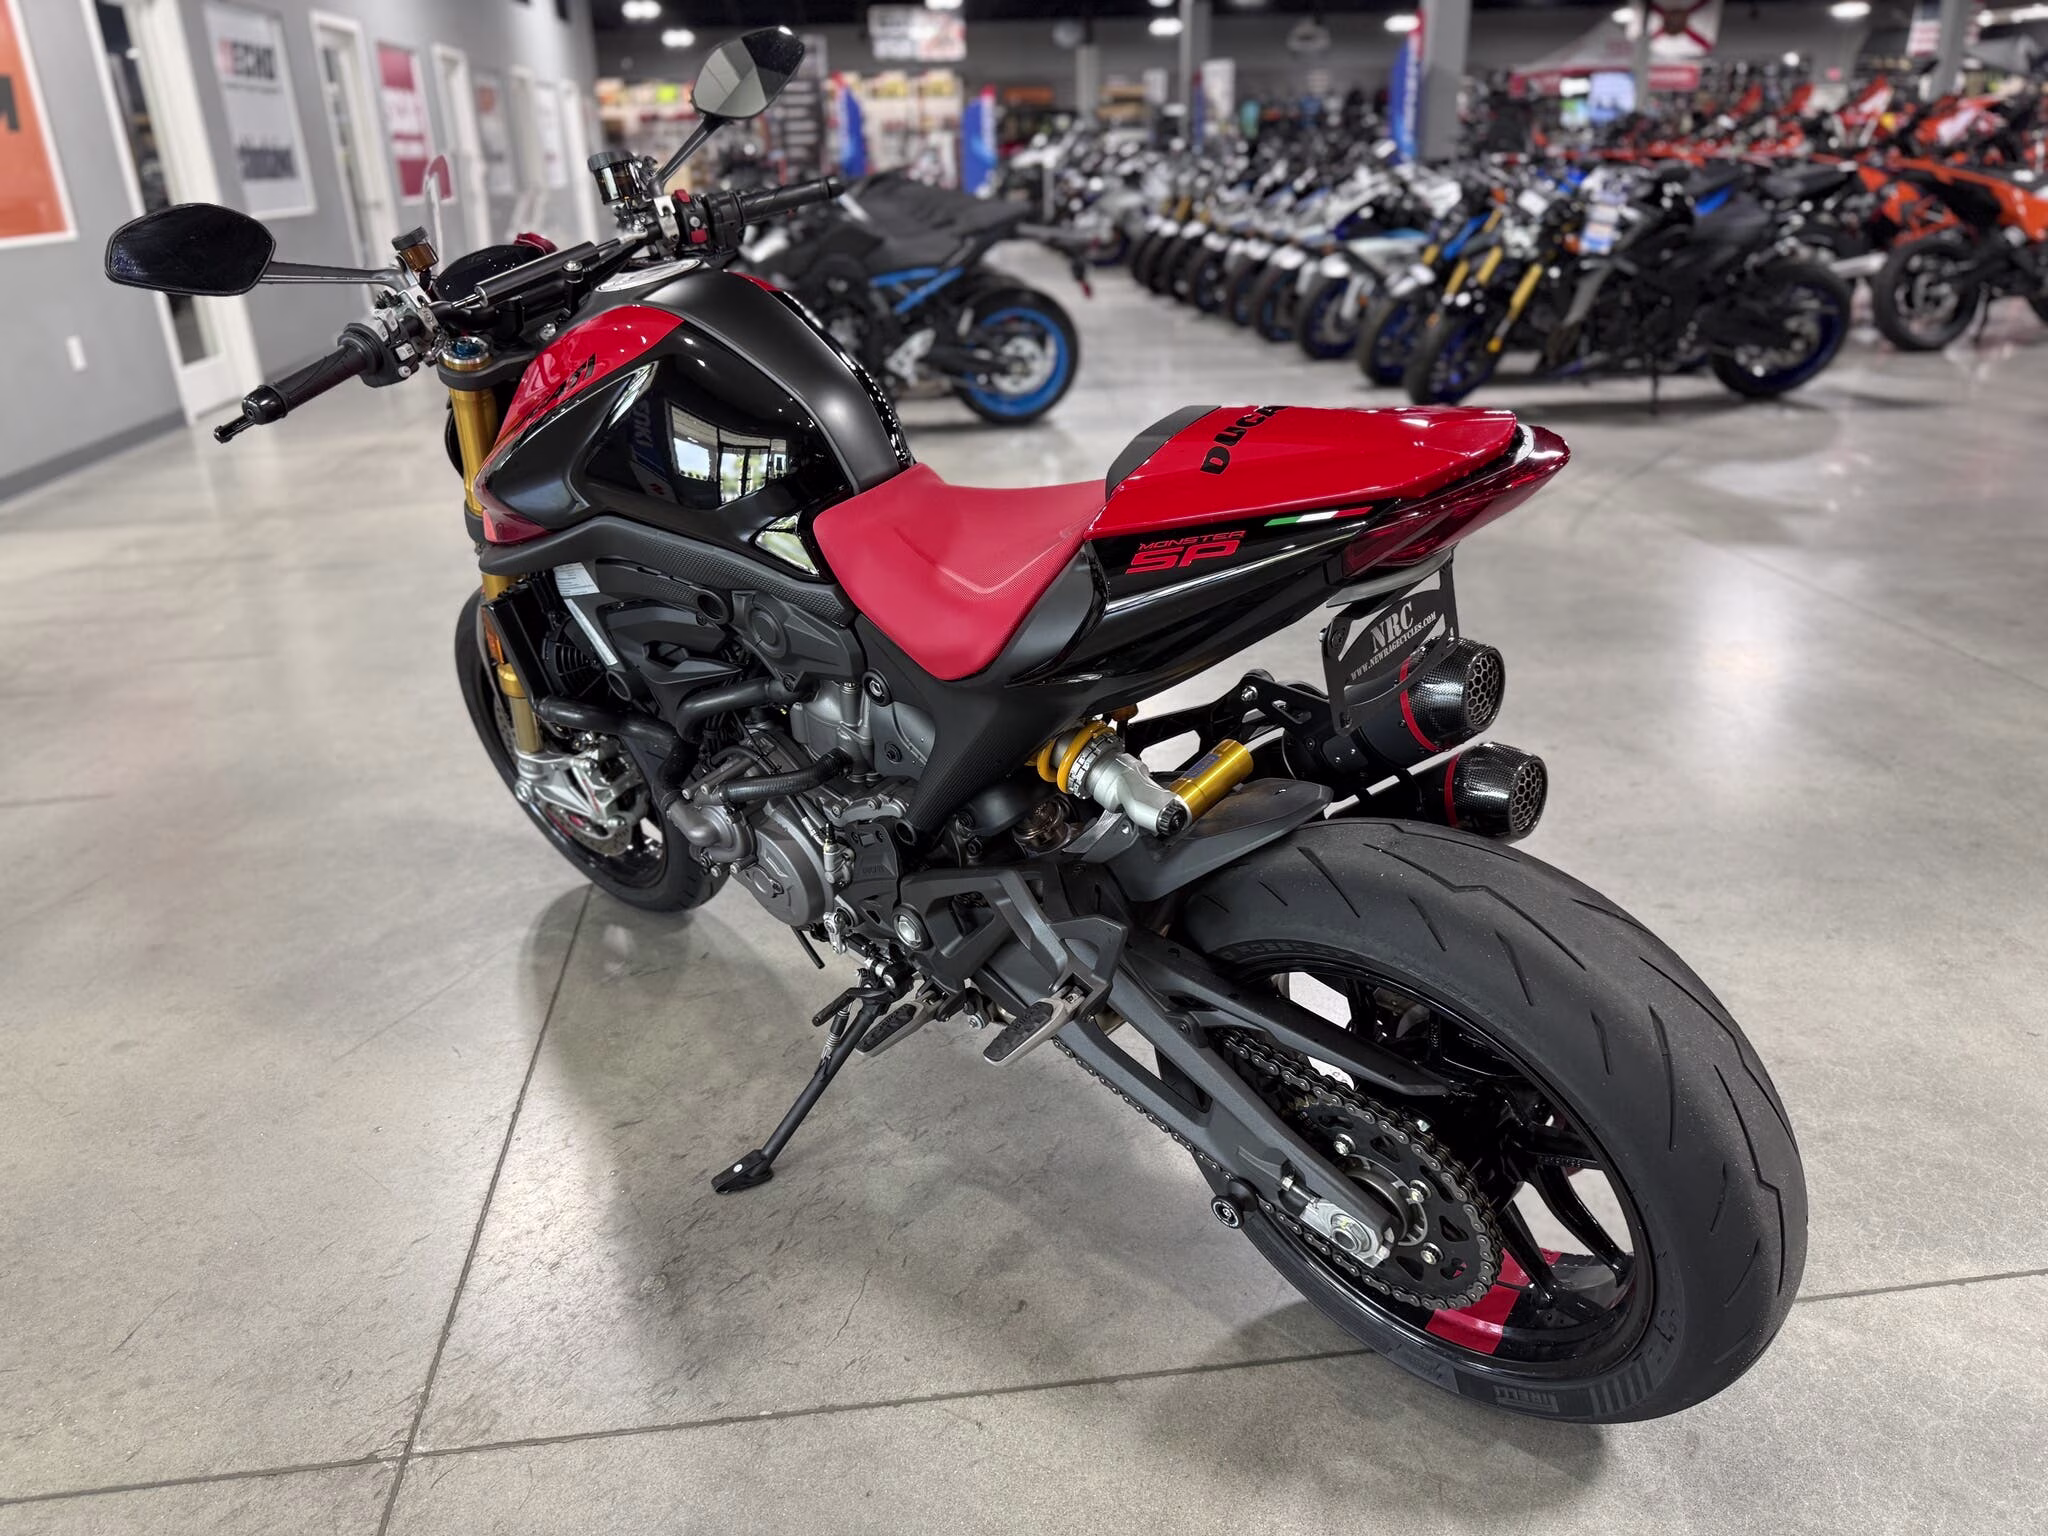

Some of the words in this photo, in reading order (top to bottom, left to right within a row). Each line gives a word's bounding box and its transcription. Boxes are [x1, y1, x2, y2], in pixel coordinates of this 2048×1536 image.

[1125, 539, 1240, 575] SP
[1139, 530, 1247, 550] MONSTER
[1350, 610, 1437, 681] WWW.NEWRAGECYCLES.COM
[1370, 601, 1414, 654] NRC
